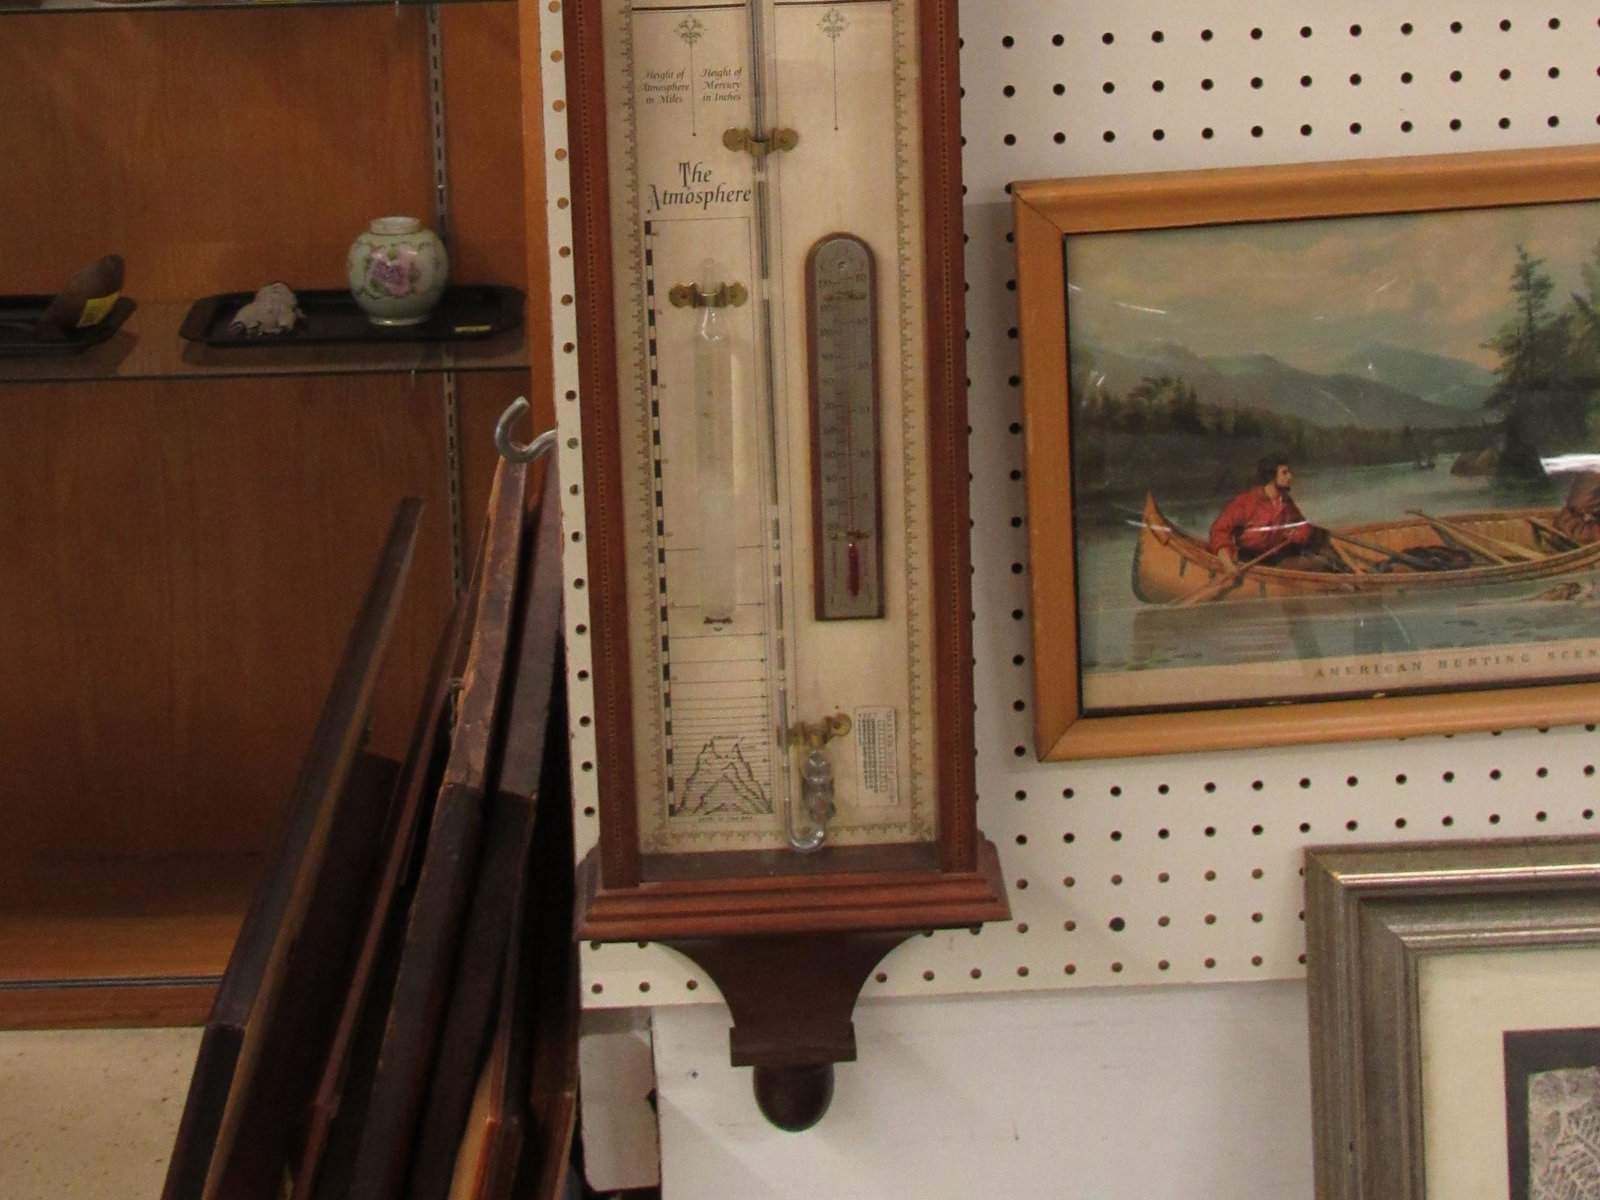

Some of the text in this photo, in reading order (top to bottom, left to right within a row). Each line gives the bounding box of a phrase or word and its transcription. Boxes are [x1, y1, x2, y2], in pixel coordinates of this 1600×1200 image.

[645, 68, 685, 81] Height of
[701, 67, 742, 80] Height of
[641, 83, 690, 95] Atmosphere
[703, 80, 742, 92] Mercury
[646, 94, 683, 104] in Miles
[714, 91, 742, 101] Inches
[679, 161, 712, 188] The
[647, 182, 752, 214] Atmosphere
[1313, 661, 1422, 678] AMERICAN
[1438, 652, 1530, 670] HUNTING
